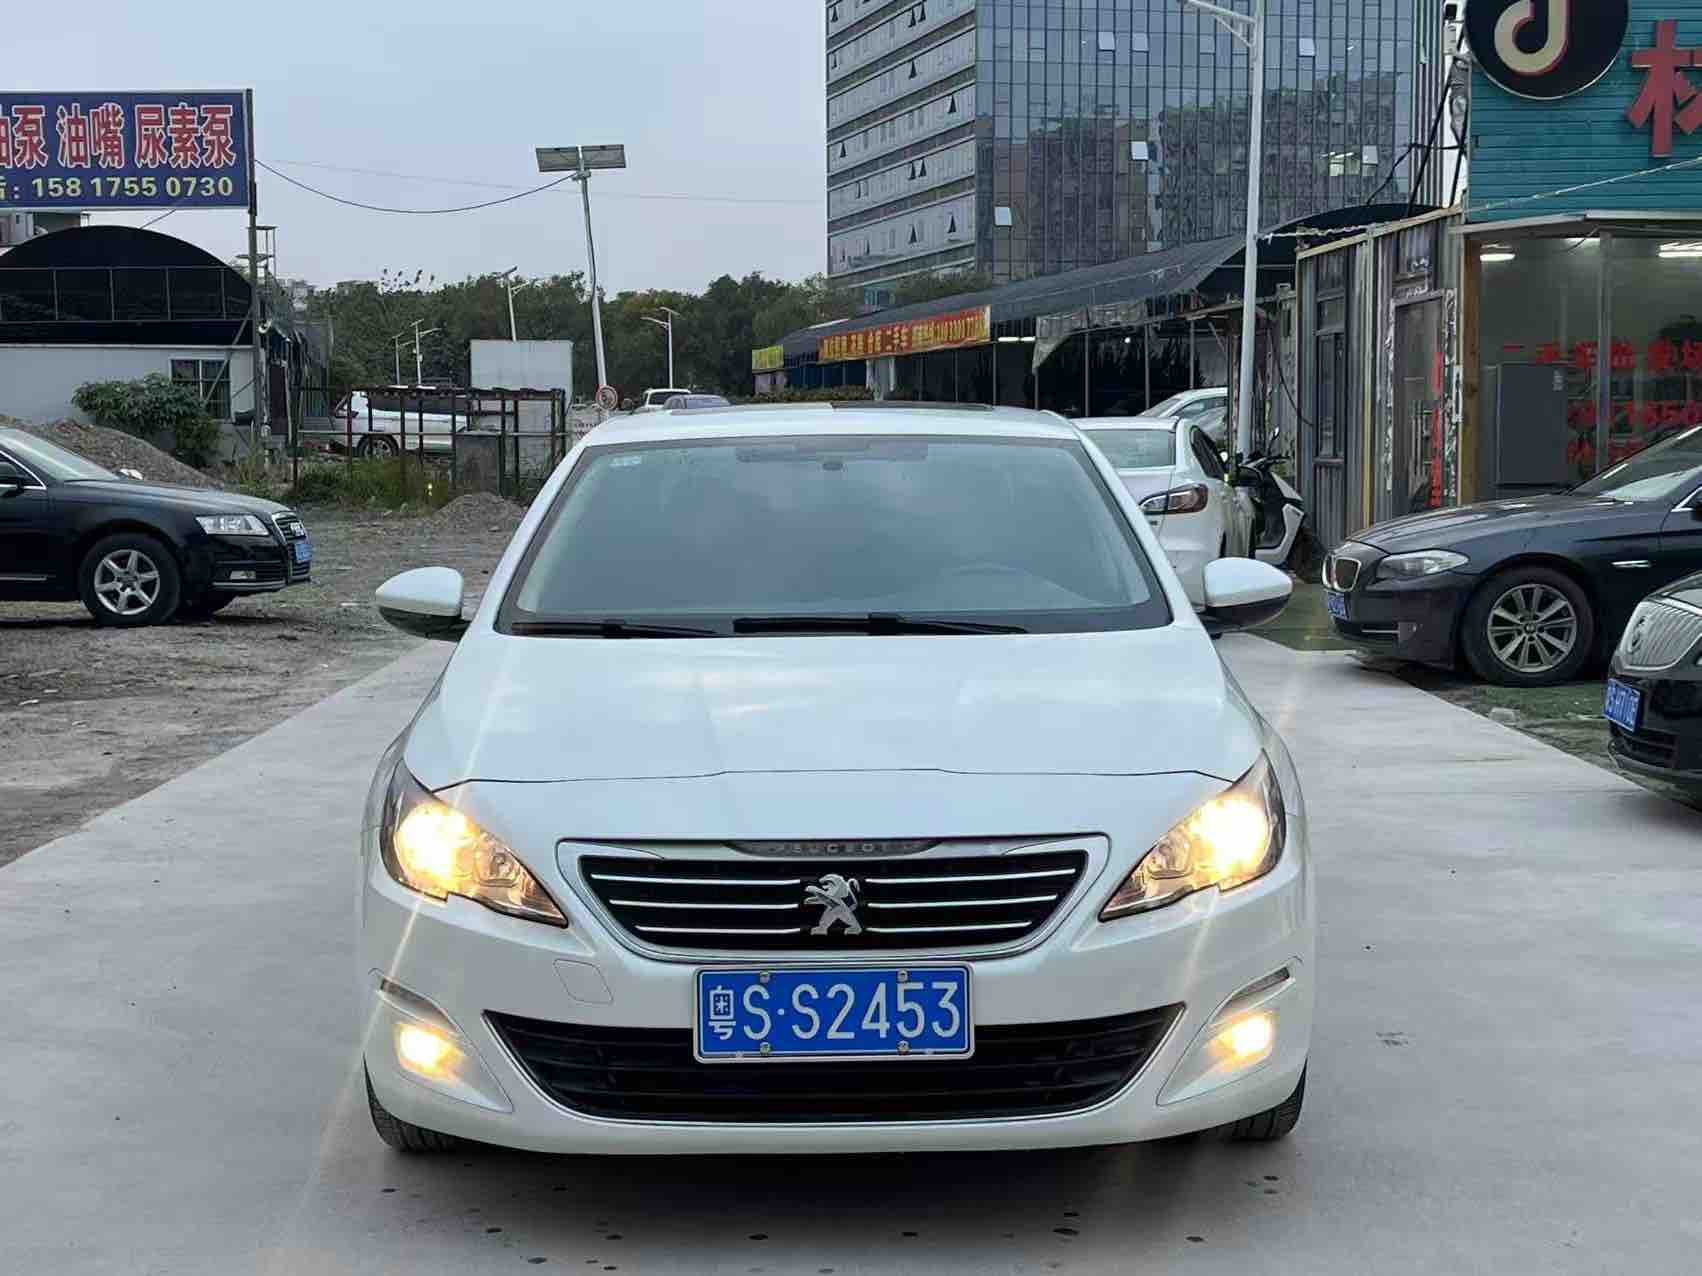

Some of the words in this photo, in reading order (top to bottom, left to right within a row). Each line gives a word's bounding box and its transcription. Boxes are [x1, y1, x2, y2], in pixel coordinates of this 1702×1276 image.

[56, 103, 124, 169] 油嘴
[135, 103, 236, 169] 尿素泵
[32, 177, 81, 197] 158
[91, 177, 157, 197] 1755
[166, 177, 233, 197] 0730
[708, 982, 960, 1041] 粤S·S2453
